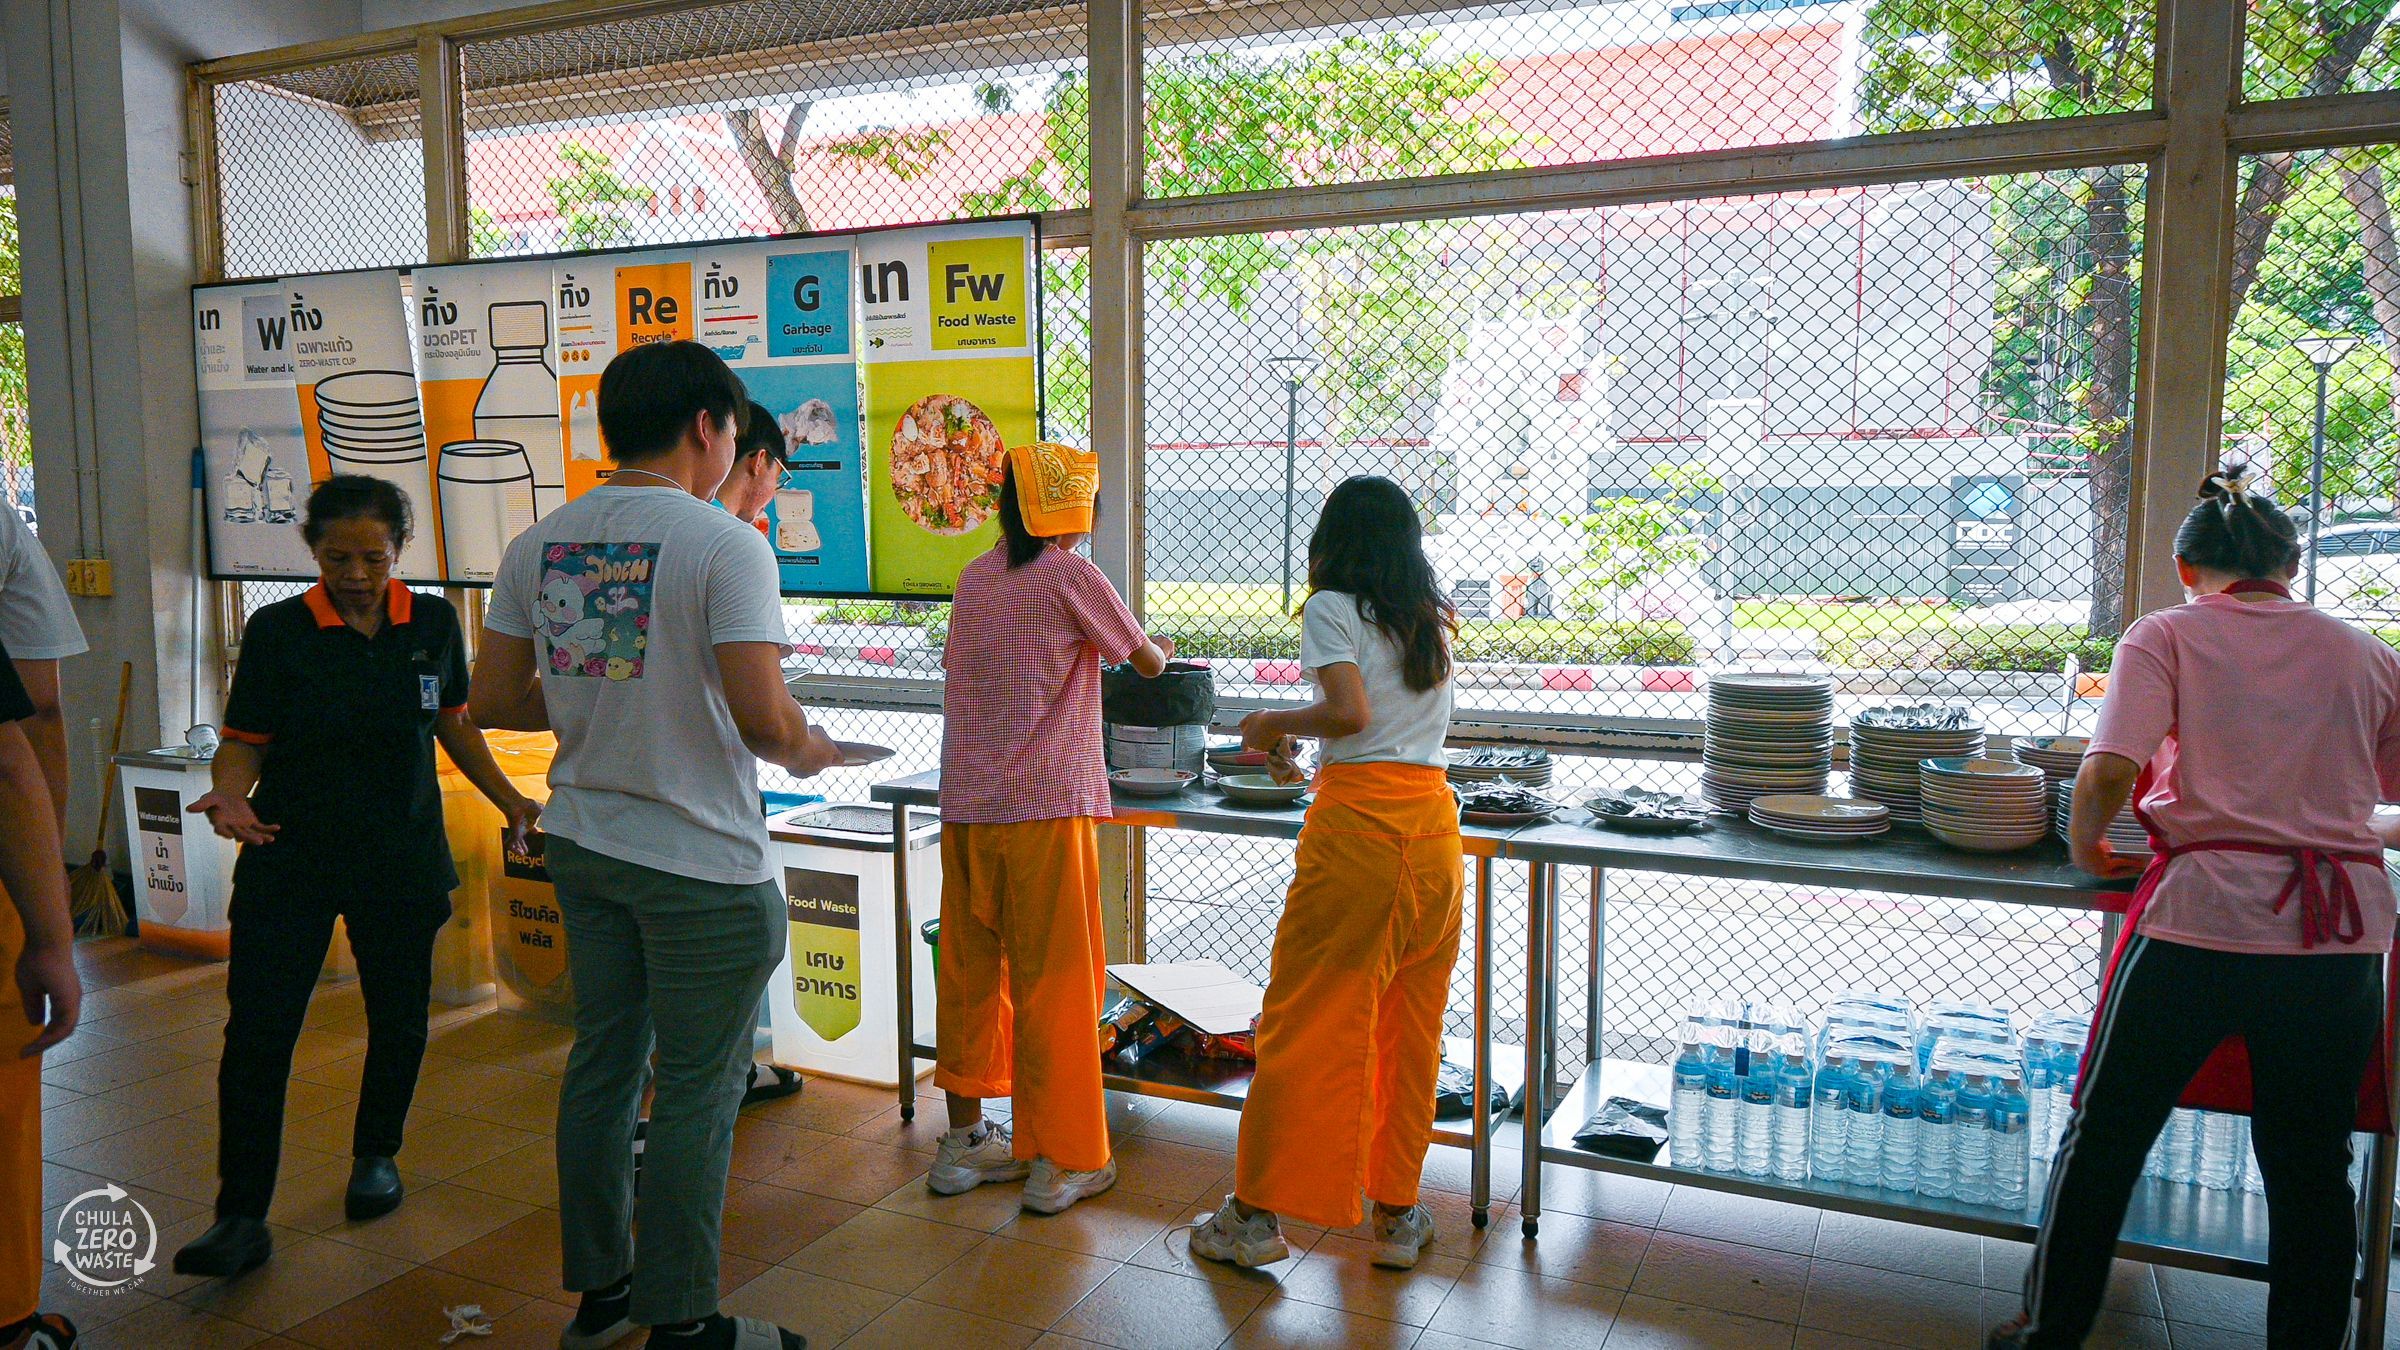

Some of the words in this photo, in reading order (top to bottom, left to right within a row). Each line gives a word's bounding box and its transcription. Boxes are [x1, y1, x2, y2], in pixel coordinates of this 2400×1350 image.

[768, 259, 774, 267] 5
[560, 273, 590, 309] ทิ้ง
[704, 261, 739, 299] ทิ้ง
[863, 260, 909, 304] เท
[945, 263, 1005, 304] Fw
[793, 275, 820, 312] G
[290, 292, 323, 332] ทิ้ง
[422, 286, 458, 327] ทิ้ง
[628, 287, 678, 326] Re
[199, 308, 220, 330] เท
[782, 322, 832, 337] Garbage
[938, 313, 970, 327] Food
[974, 313, 1016, 326] Waste
[256, 316, 286, 351] W
[246, 364, 269, 374] Water
[270, 363, 286, 373] and
[342, 357, 357, 366] CUP
[139, 811, 157, 821] Water
[158, 814, 169, 823] and
[155, 836, 169, 859] น้ำ
[147, 866, 184, 893] น้ำแข็ง
[788, 895, 817, 909] Food
[820, 899, 857, 915] Waste
[519, 928, 554, 949] พลัส
[805, 950, 845, 971] เศษ
[795, 976, 857, 1001] อาหาร
